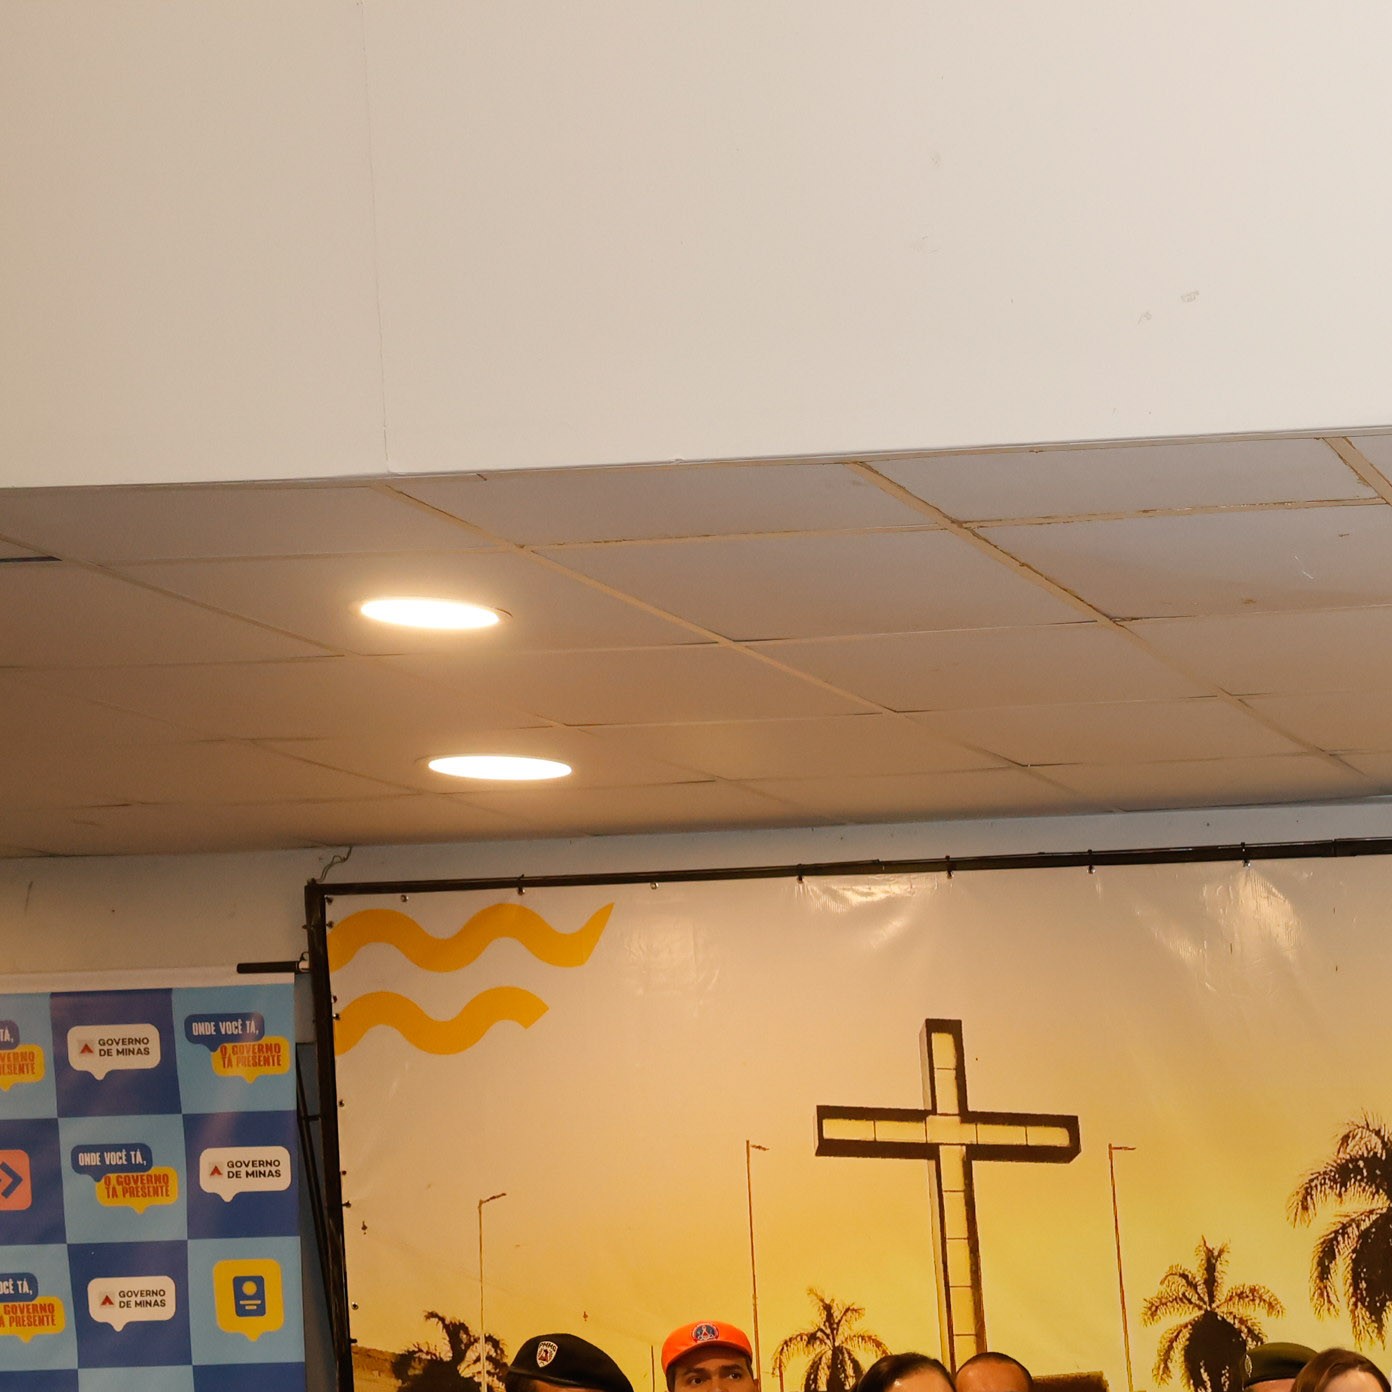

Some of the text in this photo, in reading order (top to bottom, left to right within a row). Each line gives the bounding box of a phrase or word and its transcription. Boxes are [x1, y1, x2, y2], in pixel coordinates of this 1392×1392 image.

[192, 1017, 260, 1037] ONDE VOCÊ TÁ,
[98, 1037, 150, 1046] GOVERNO
[99, 1047, 150, 1057] DE MINAS
[231, 1042, 282, 1056] GOVERNO
[236, 1053, 282, 1068] PRESENTE
[78, 1149, 147, 1166] ONDE VOCÊ TÁ,
[227, 1159, 281, 1168] GOVERNO
[116, 1173, 170, 1186] GOVERNO
[227, 1169, 281, 1179] DE MINAS
[121, 1184, 170, 1198] PRESENTE
[118, 1289, 166, 1298] GOVERNO
[4, 1303, 55, 1316] GOVERNO
[119, 1299, 166, 1309] DE MINAS
[9, 1315, 56, 1328] PRESENTE
